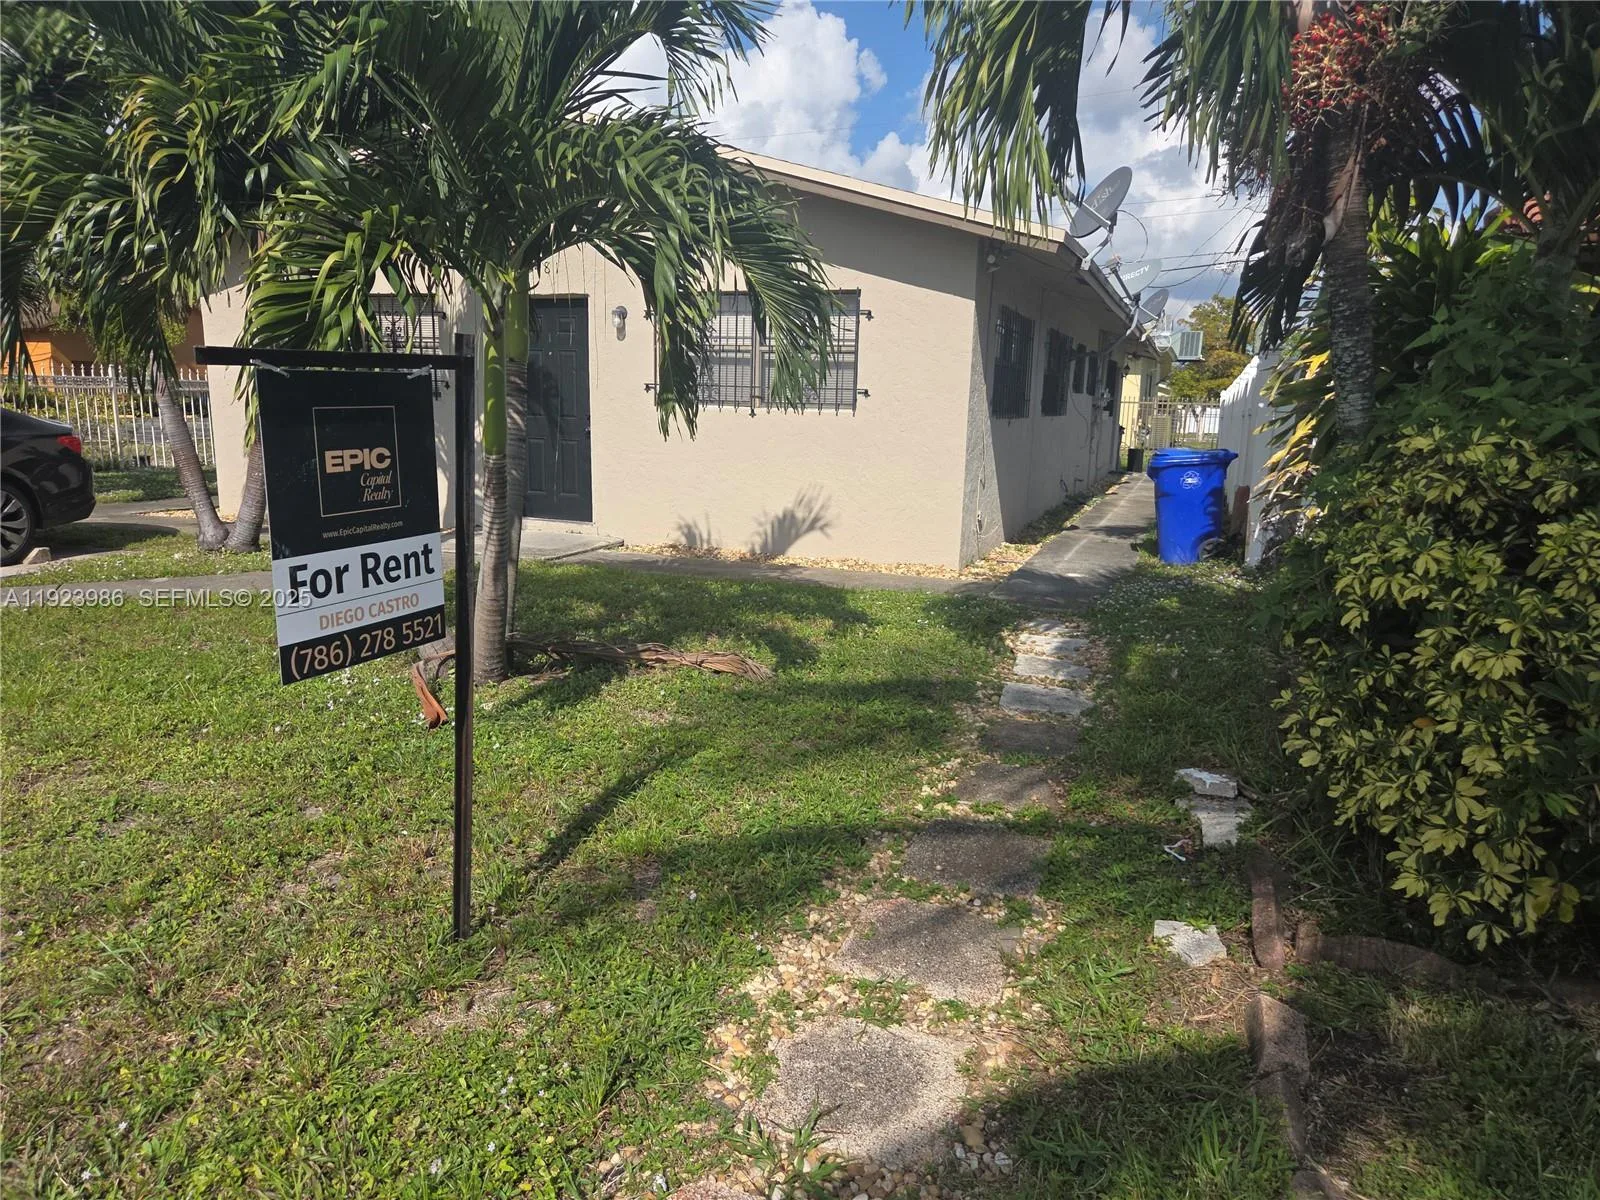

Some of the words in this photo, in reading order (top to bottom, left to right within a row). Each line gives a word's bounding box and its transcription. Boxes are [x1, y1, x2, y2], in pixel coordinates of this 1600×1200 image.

[325, 447, 391, 474] EPIC
[360, 470, 392, 489] Capital
[363, 486, 394, 503] Realty
[322, 520, 404, 538] www.EpicCapitalRealty.com
[289, 564, 349, 604] For
[360, 543, 435, 588] Rent
[319, 606, 365, 630] DIEGO
[368, 593, 420, 618] CASTRO
[291, 634, 353, 680] (786)
[359, 627, 396, 658] 278
[402, 613, 442, 645] 5521
